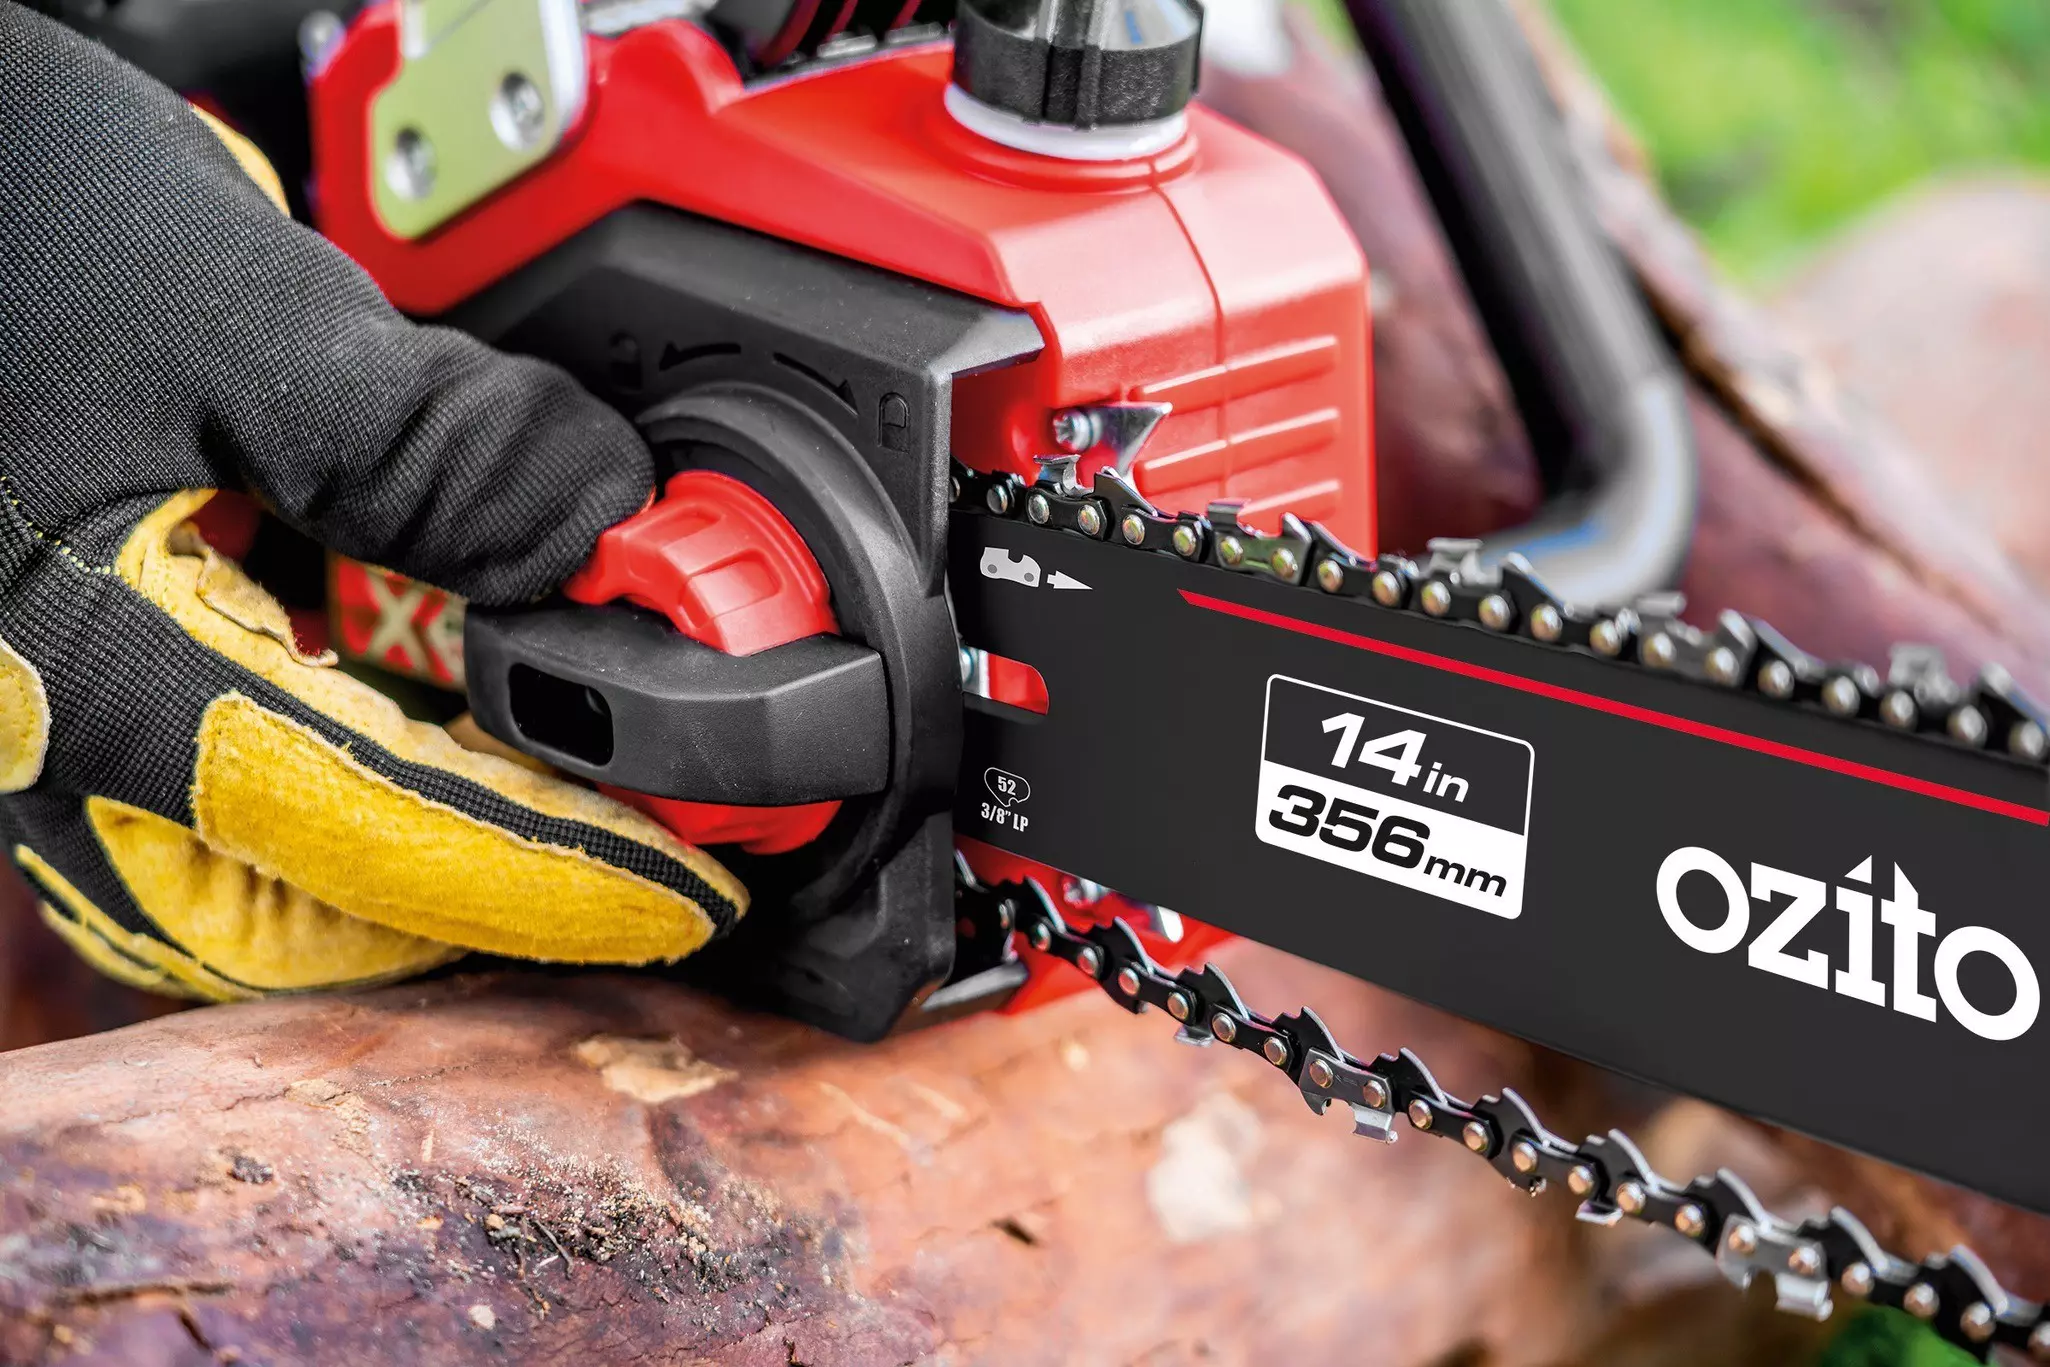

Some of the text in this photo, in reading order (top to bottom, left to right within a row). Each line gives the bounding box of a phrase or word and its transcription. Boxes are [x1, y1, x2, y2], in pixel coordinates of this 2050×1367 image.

[997, 775, 1017, 796] 52
[1012, 813, 1029, 832] LP
[1656, 846, 2041, 1041] ozito
